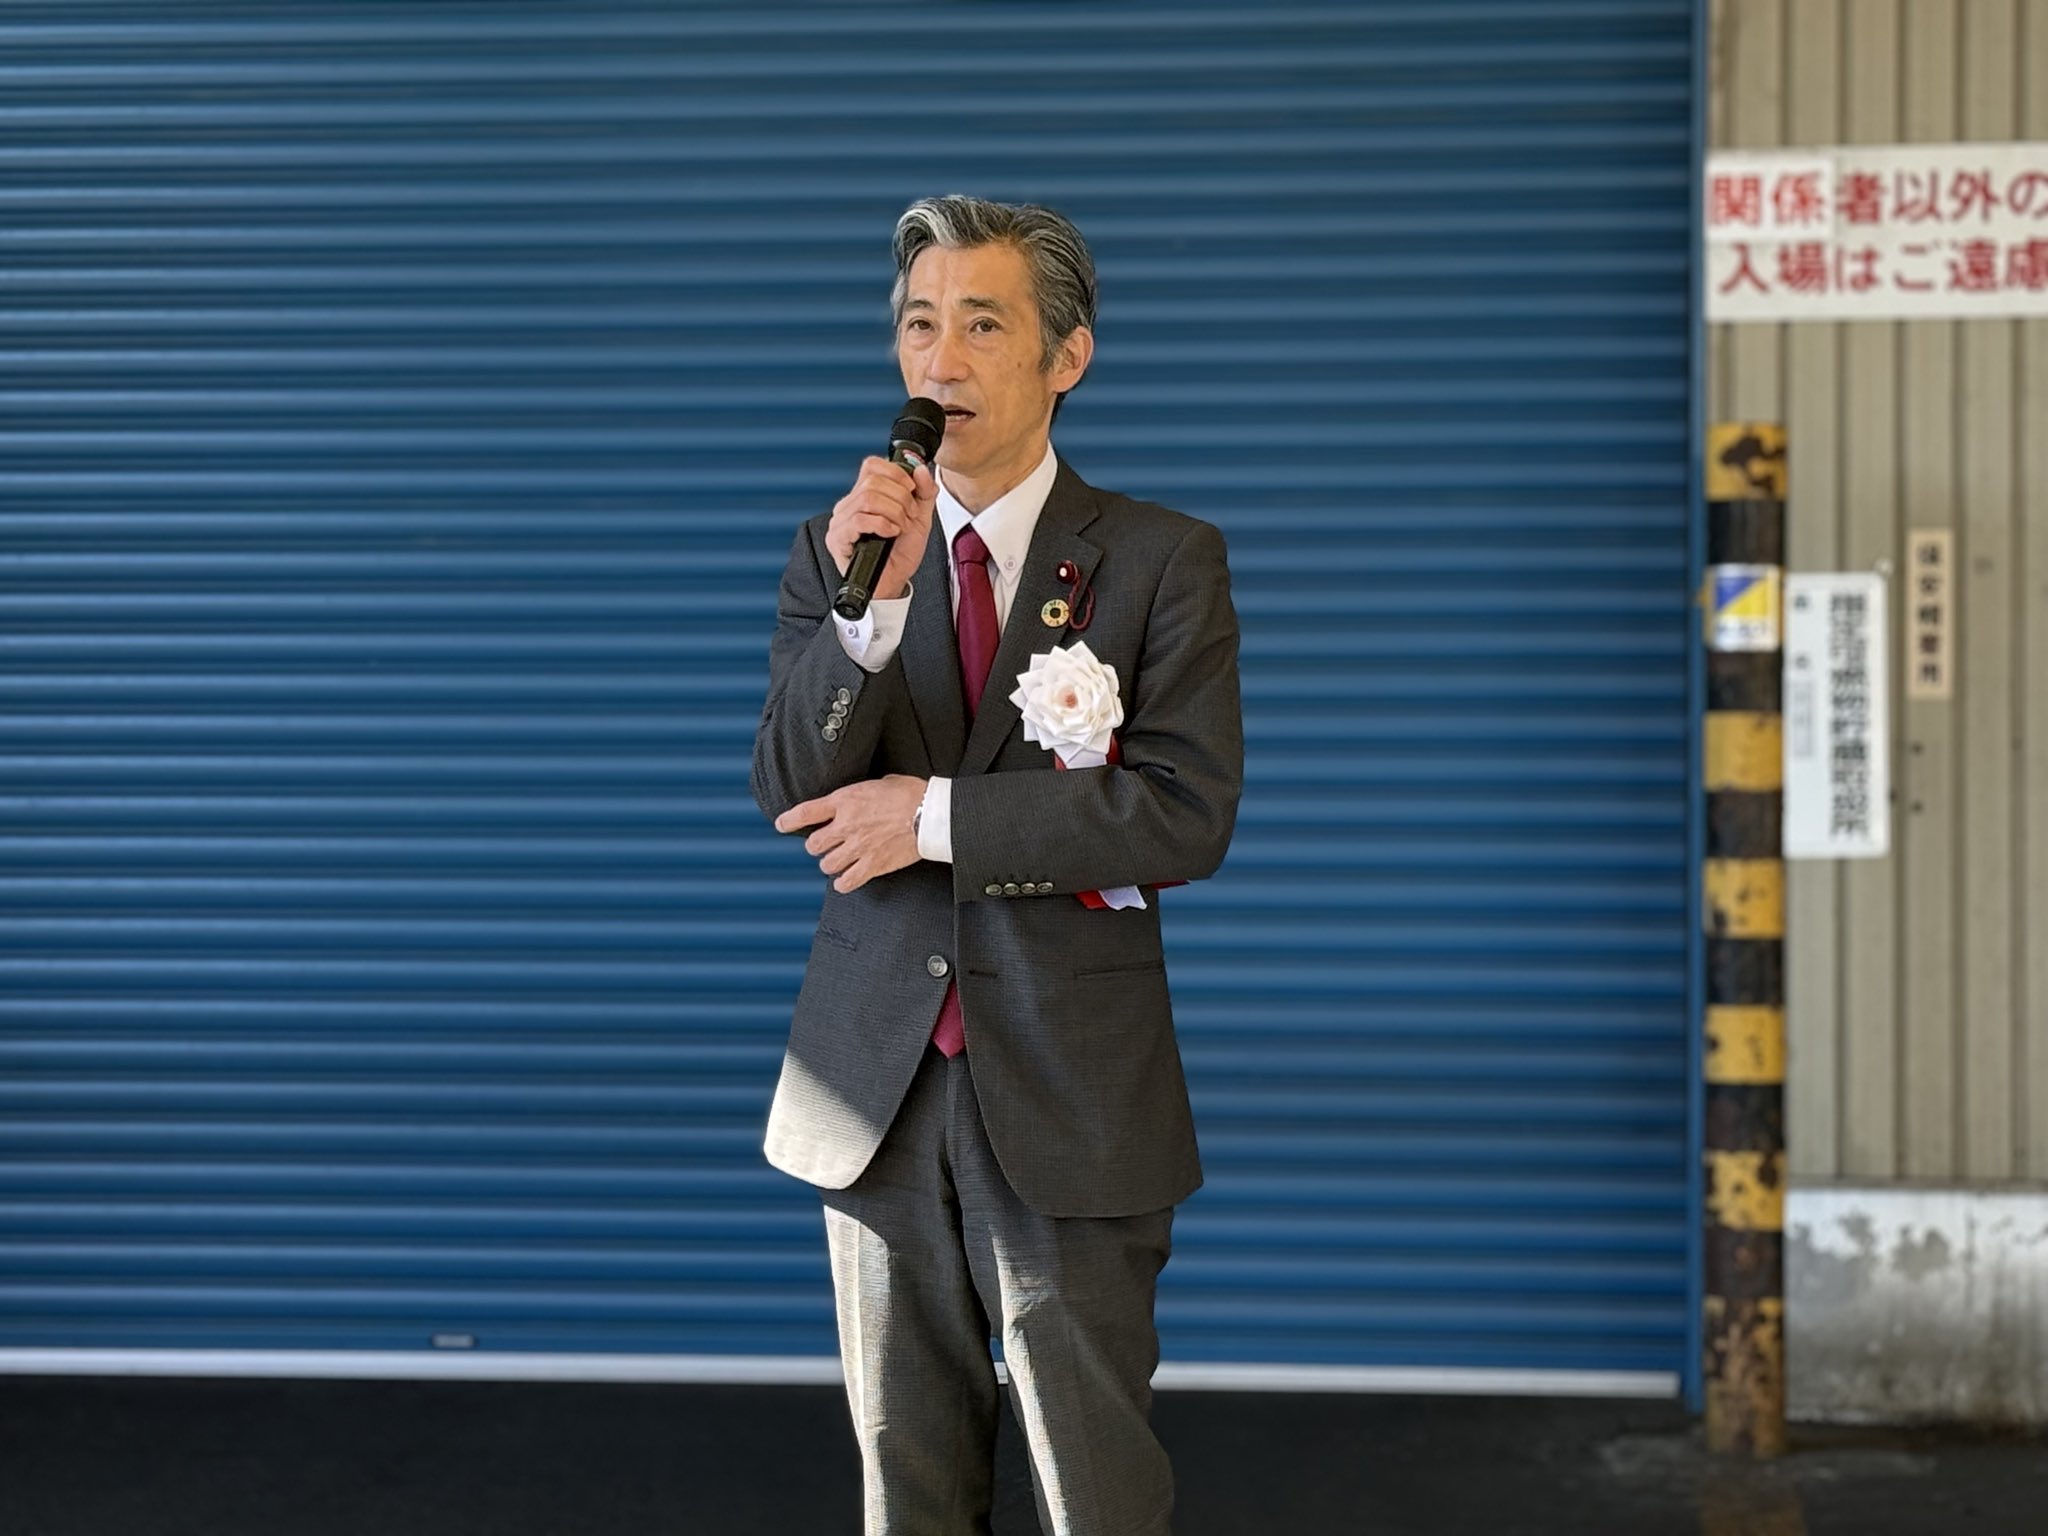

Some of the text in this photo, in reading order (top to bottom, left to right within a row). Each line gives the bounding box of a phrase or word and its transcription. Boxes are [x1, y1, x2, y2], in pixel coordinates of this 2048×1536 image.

[1709, 168, 2048, 227] 関係者以外の
